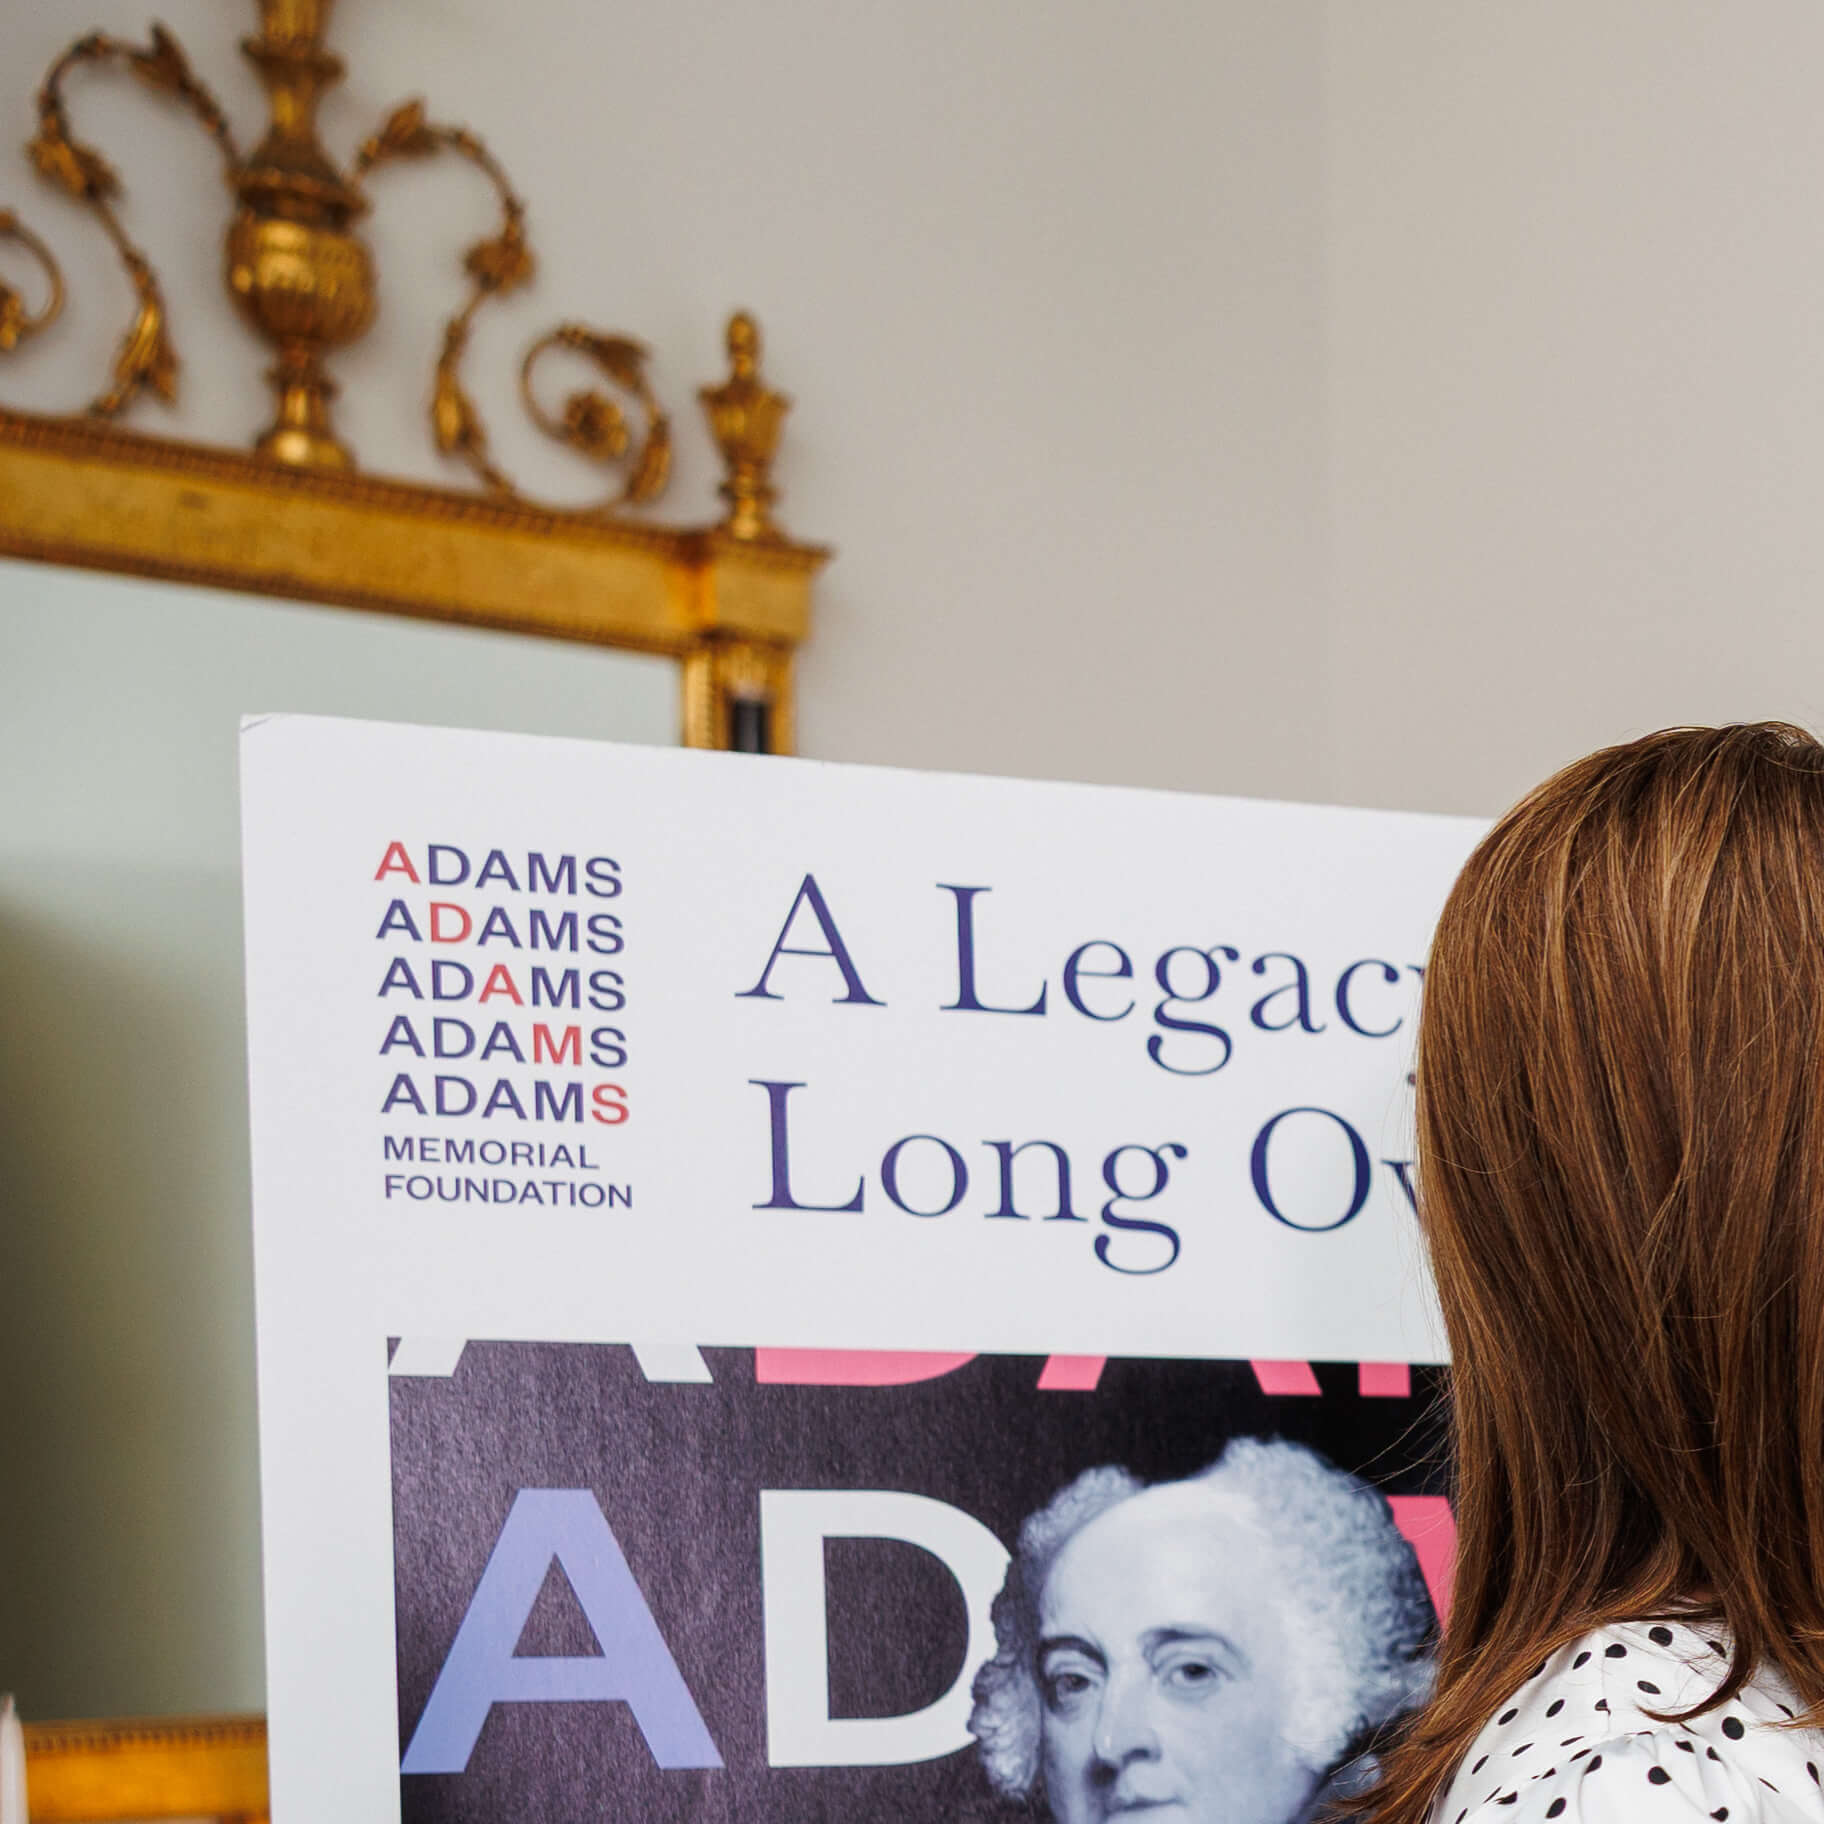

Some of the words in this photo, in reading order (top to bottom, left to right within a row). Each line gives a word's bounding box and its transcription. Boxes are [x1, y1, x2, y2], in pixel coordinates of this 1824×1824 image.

[375, 842, 622, 898] ADAMS
[376, 899, 624, 954] ADAMS
[378, 957, 625, 1011] ADAMS
[735, 873, 886, 1006] A
[936, 884, 1424, 1075] Legac
[379, 1016, 627, 1068] ADAMS
[381, 1073, 629, 1124] ADAMS
[384, 1136, 598, 1168] MEMORIAL
[749, 1080, 1187, 1274] Long
[385, 1175, 632, 1208] FOUNDATION
